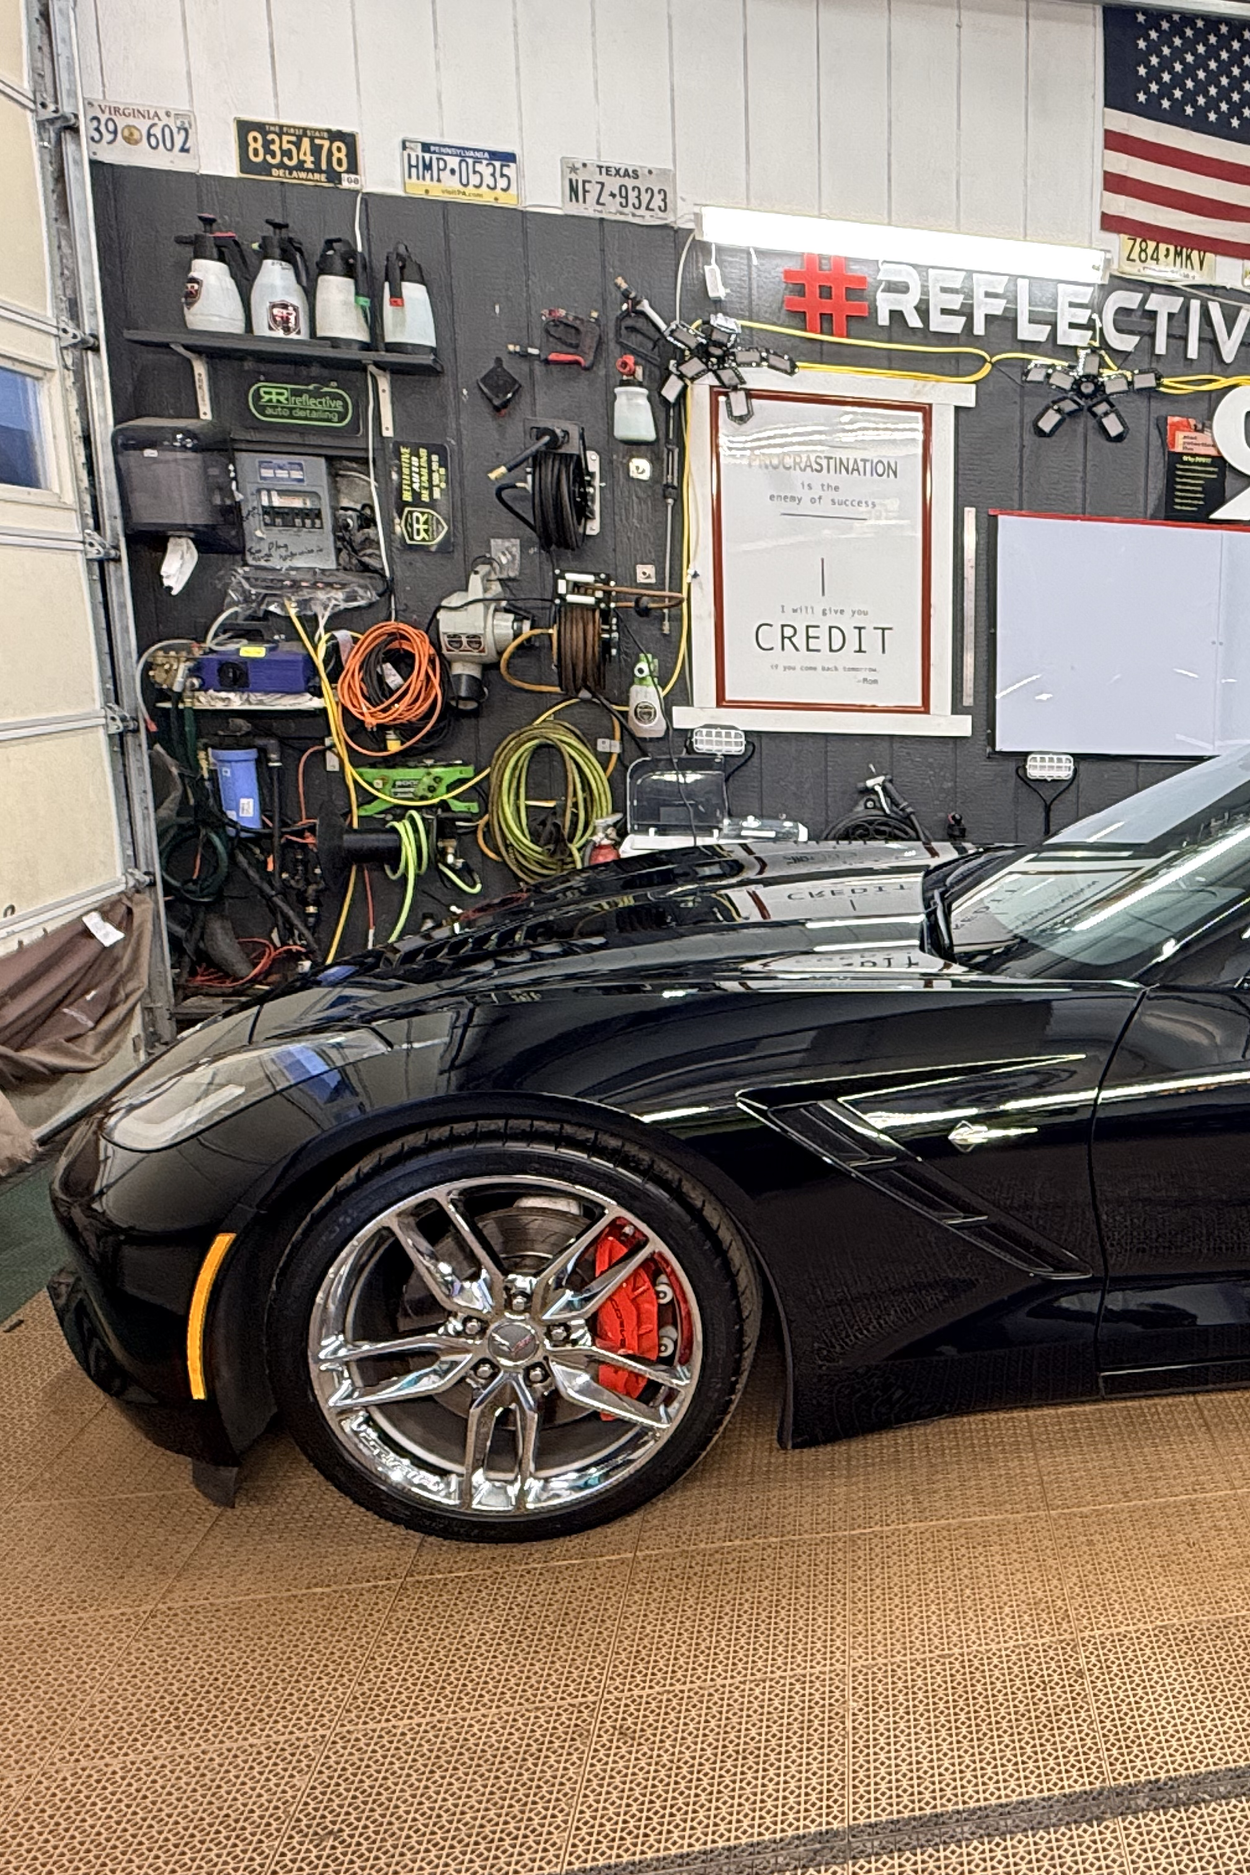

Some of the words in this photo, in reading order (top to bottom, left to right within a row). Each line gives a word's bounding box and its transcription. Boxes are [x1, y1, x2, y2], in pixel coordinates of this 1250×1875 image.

[97, 103, 162, 122] VIRGINIA
[89, 115, 119, 145] 39
[146, 122, 191, 154] 602
[247, 130, 348, 173] 835478
[429, 145, 490, 160] PENNSYLVANIA
[270, 167, 328, 182] DELAWARE
[596, 164, 640, 180] TEXAS
[291, 393, 344, 409] reflective
[264, 406, 290, 417] auto
[292, 408, 339, 422] detailing
[748, 453, 898, 479] PROCRASTINATION
[800, 480, 813, 491] is
[820, 482, 840, 493] the
[768, 493, 803, 506] enemy
[809, 494, 823, 505] of
[830, 497, 877, 509] success
[780, 604, 786, 614] I
[791, 605, 816, 616] will
[821, 606, 845, 617] give
[850, 608, 869, 618] you
[755, 622, 894, 655] CREDIT
